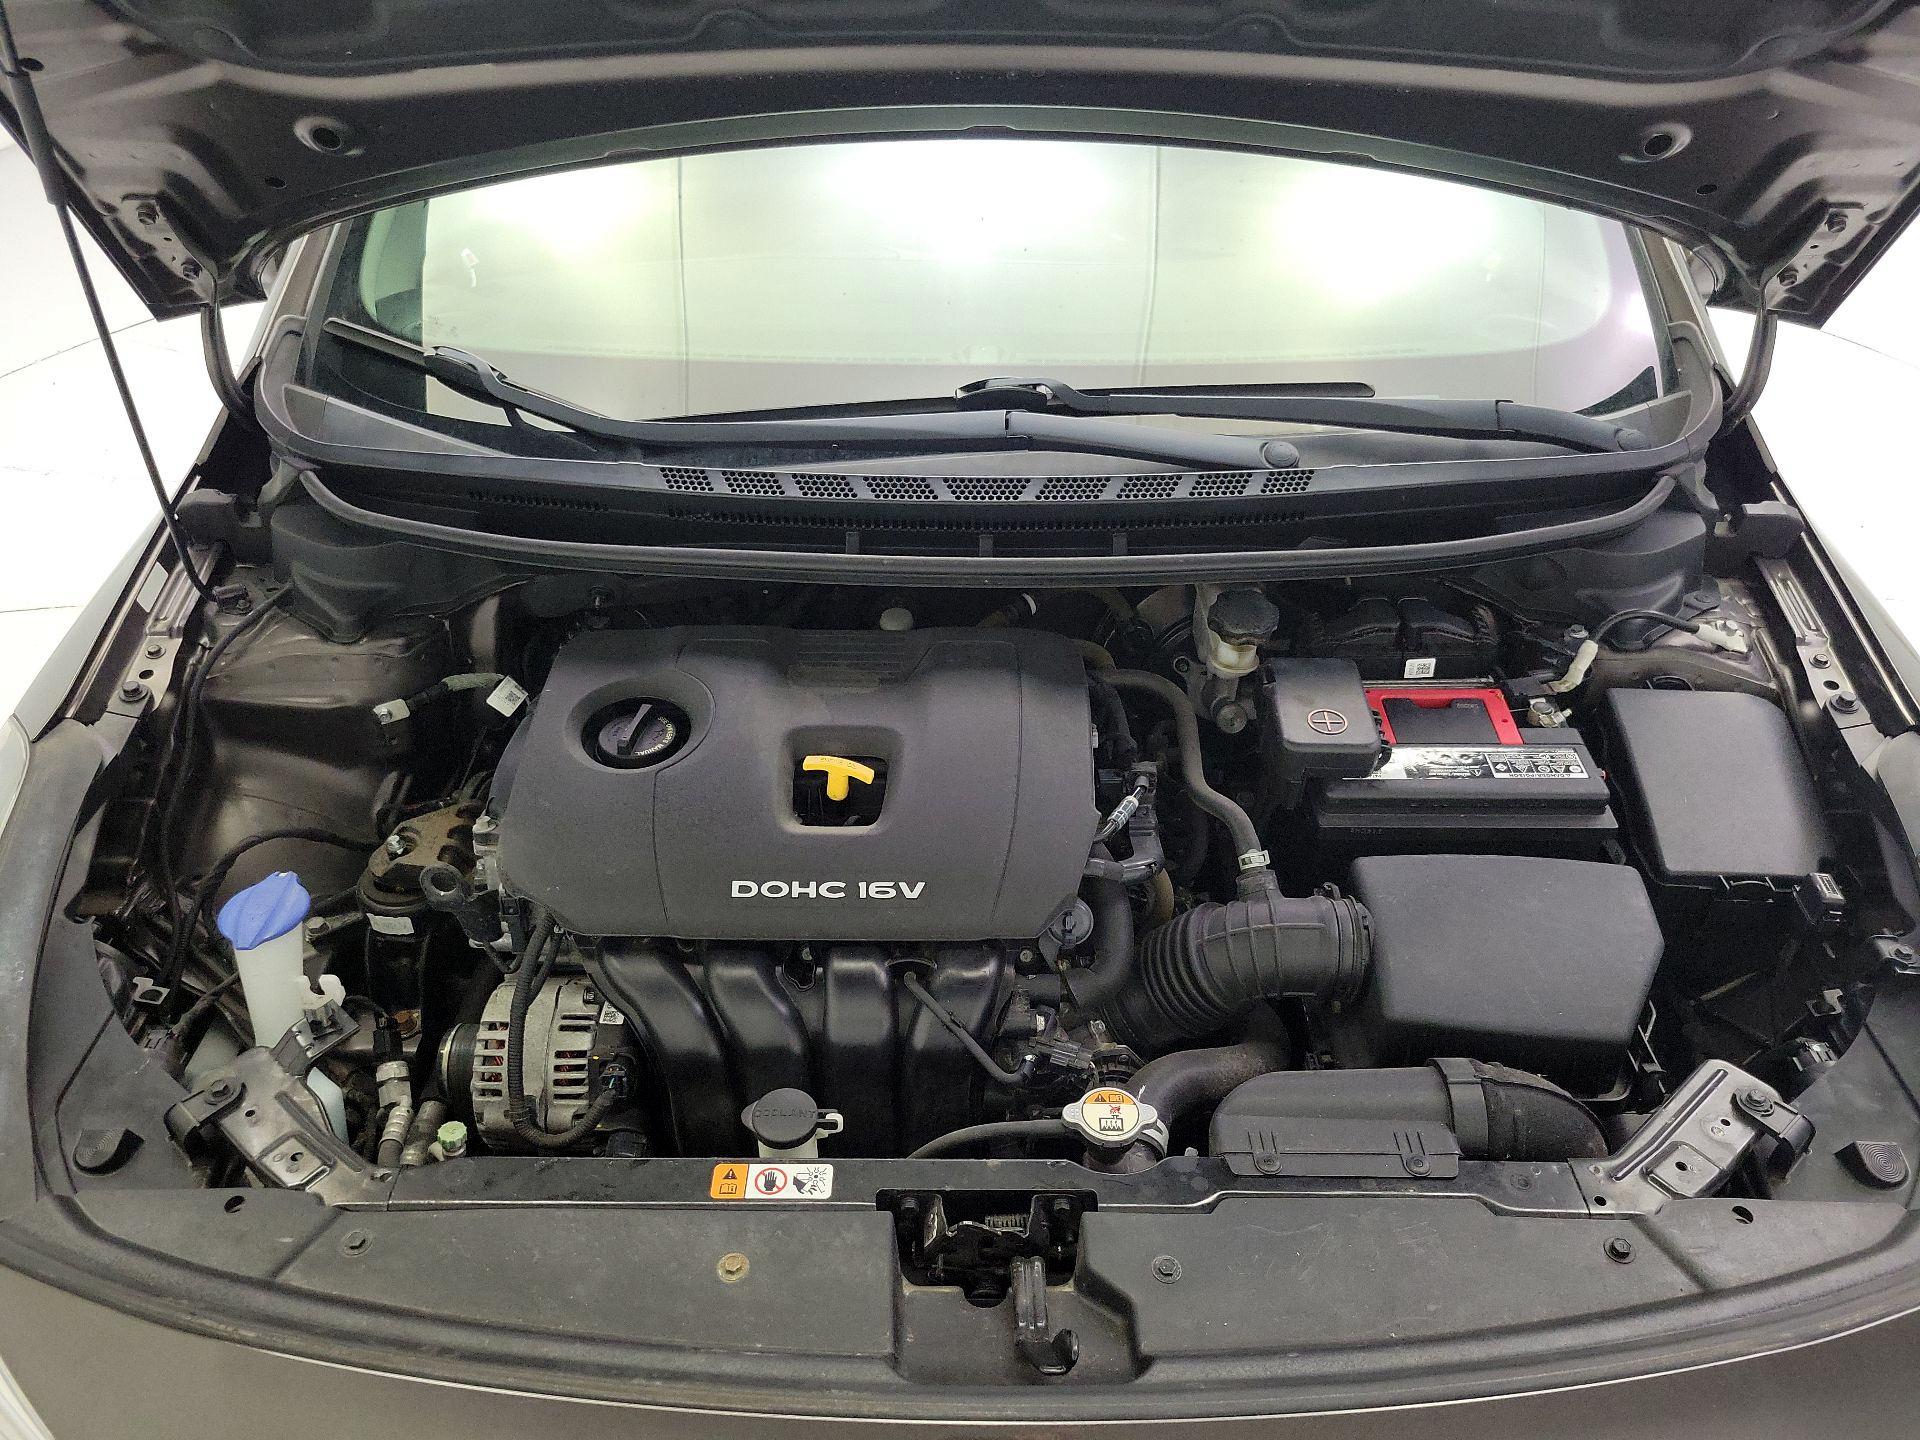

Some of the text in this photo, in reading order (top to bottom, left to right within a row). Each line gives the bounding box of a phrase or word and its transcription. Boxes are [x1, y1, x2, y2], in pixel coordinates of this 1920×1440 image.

[634, 743, 664, 756] MANUAL
[731, 880, 926, 899] DOHC 16V
[753, 1108, 816, 1119] COOLANT
